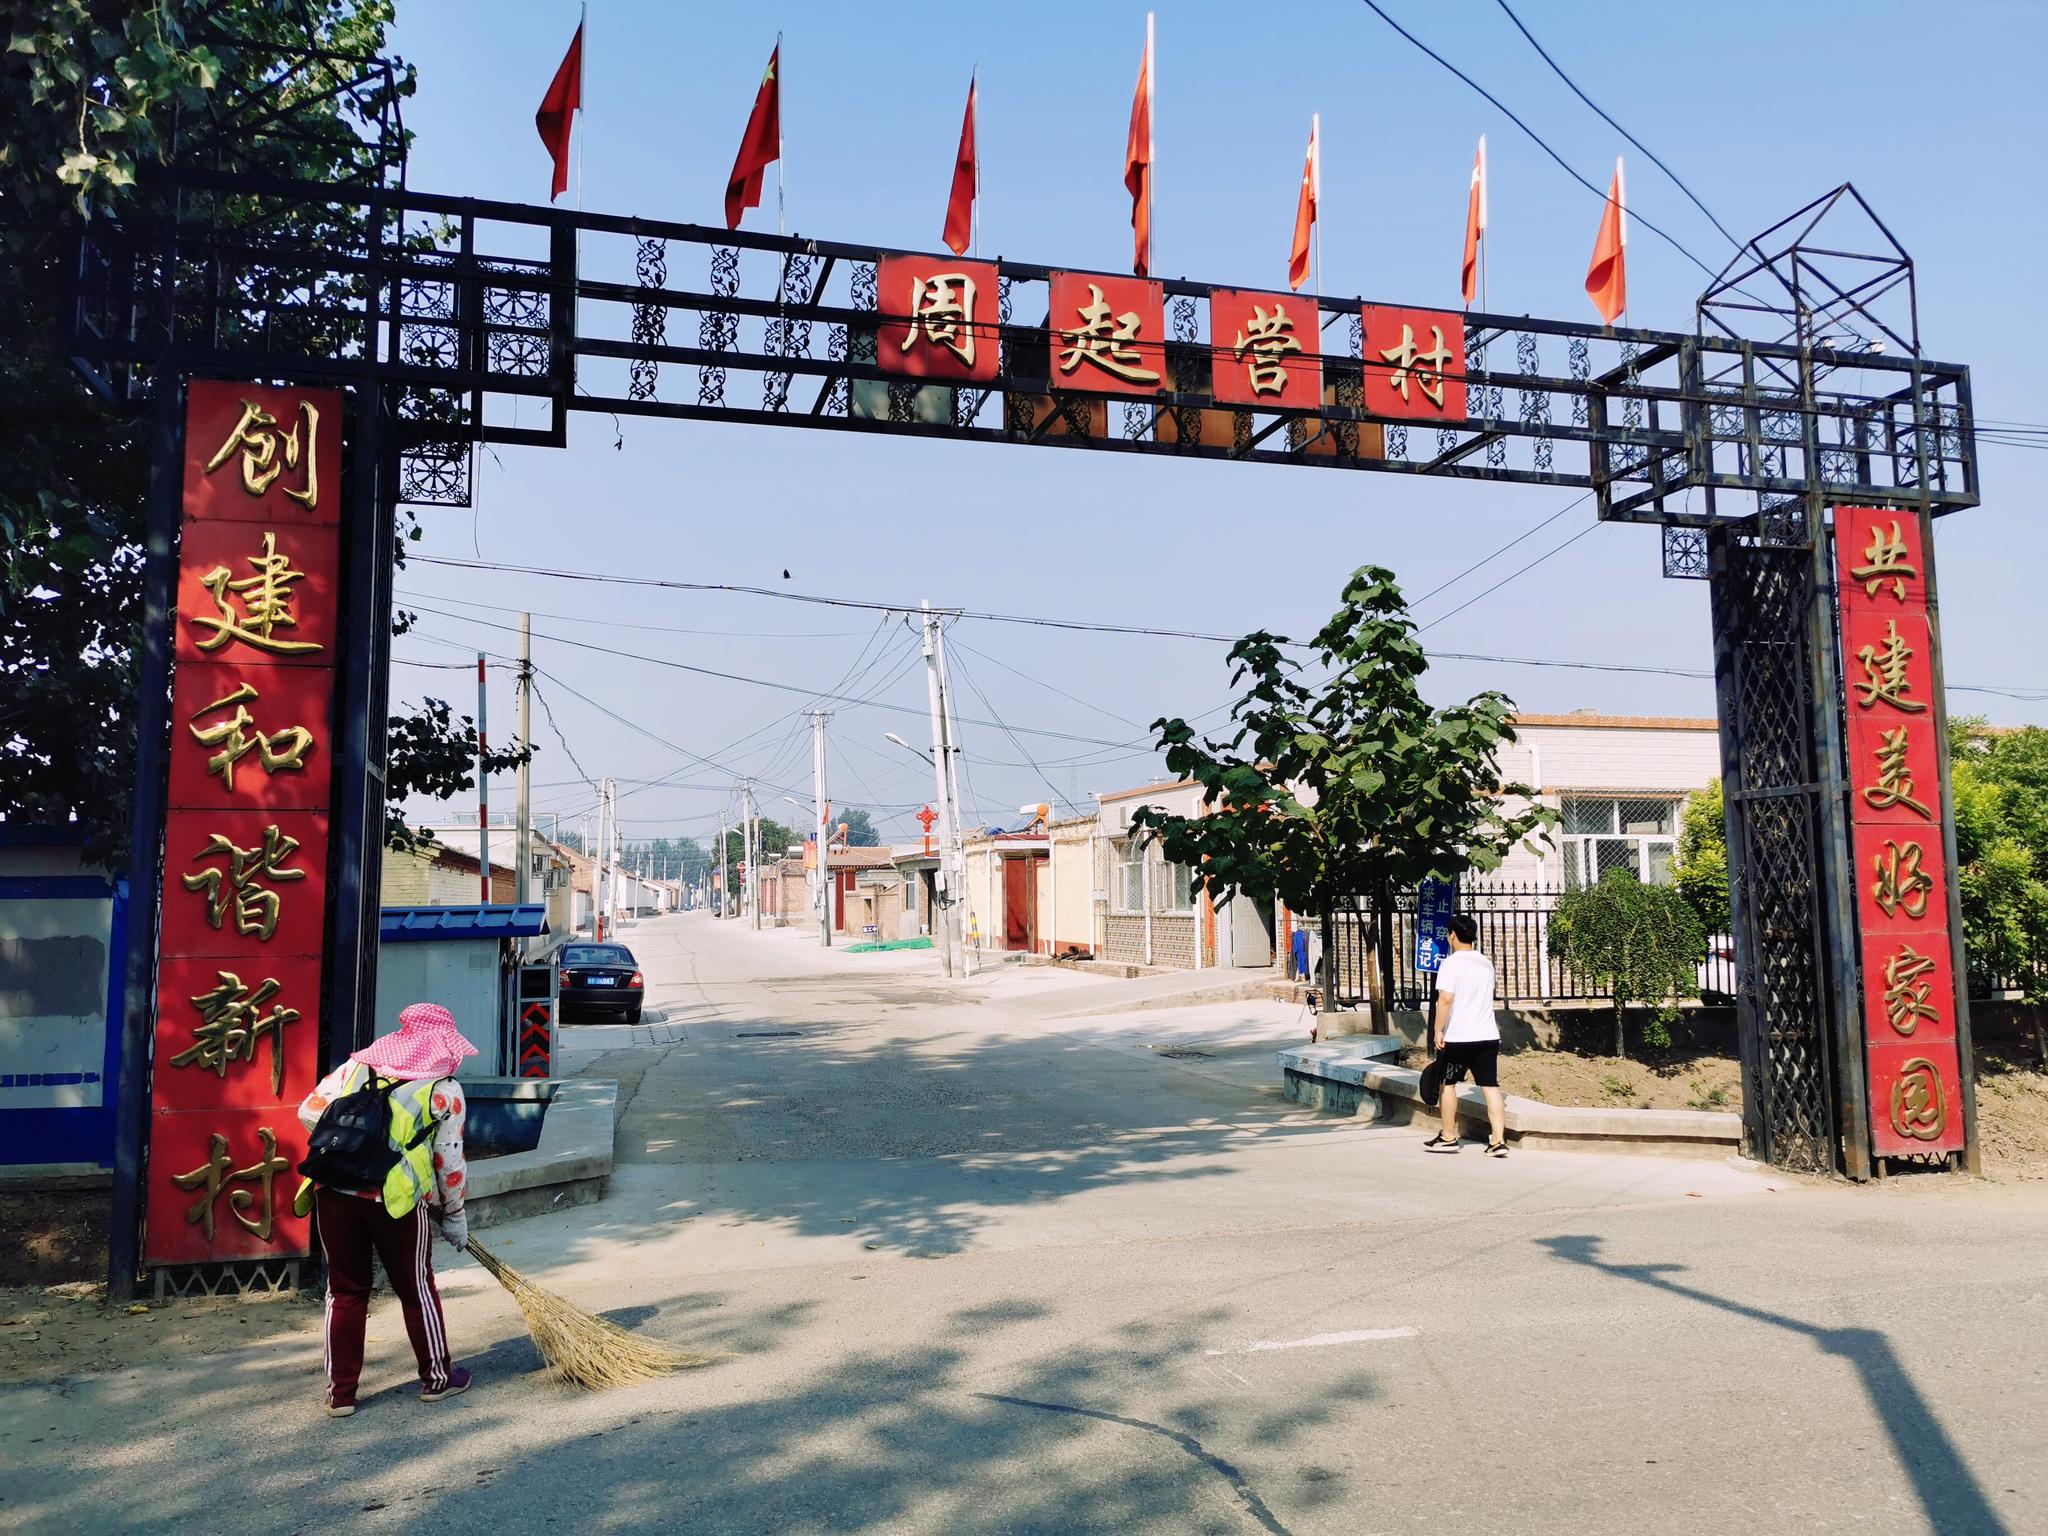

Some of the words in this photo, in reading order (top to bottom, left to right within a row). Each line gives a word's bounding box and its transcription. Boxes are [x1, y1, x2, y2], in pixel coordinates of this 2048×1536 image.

[902, 273, 1454, 407] 周起营村
[169, 398, 324, 1244] 创建和谐新村
[1850, 520, 1946, 1141] 共建美好家园
